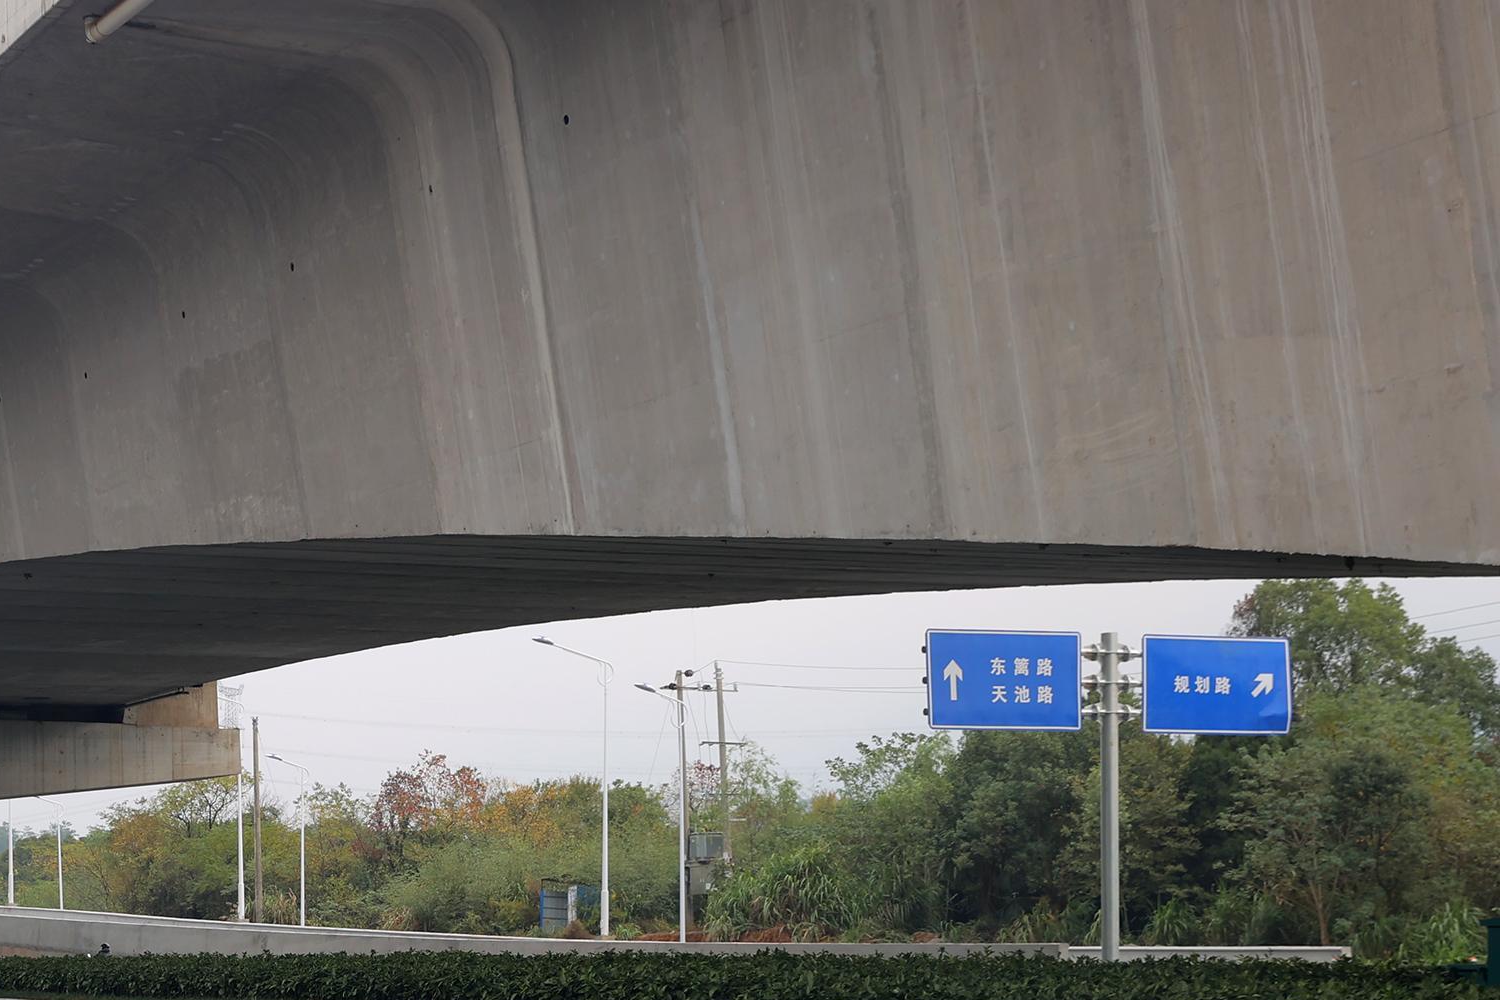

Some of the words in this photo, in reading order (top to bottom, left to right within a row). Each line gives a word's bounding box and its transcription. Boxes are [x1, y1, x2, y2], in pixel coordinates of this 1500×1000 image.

[990, 657, 1054, 677] 东篱路
[991, 685, 1054, 705] 天池路
[1173, 675, 1232, 696] 规划路
